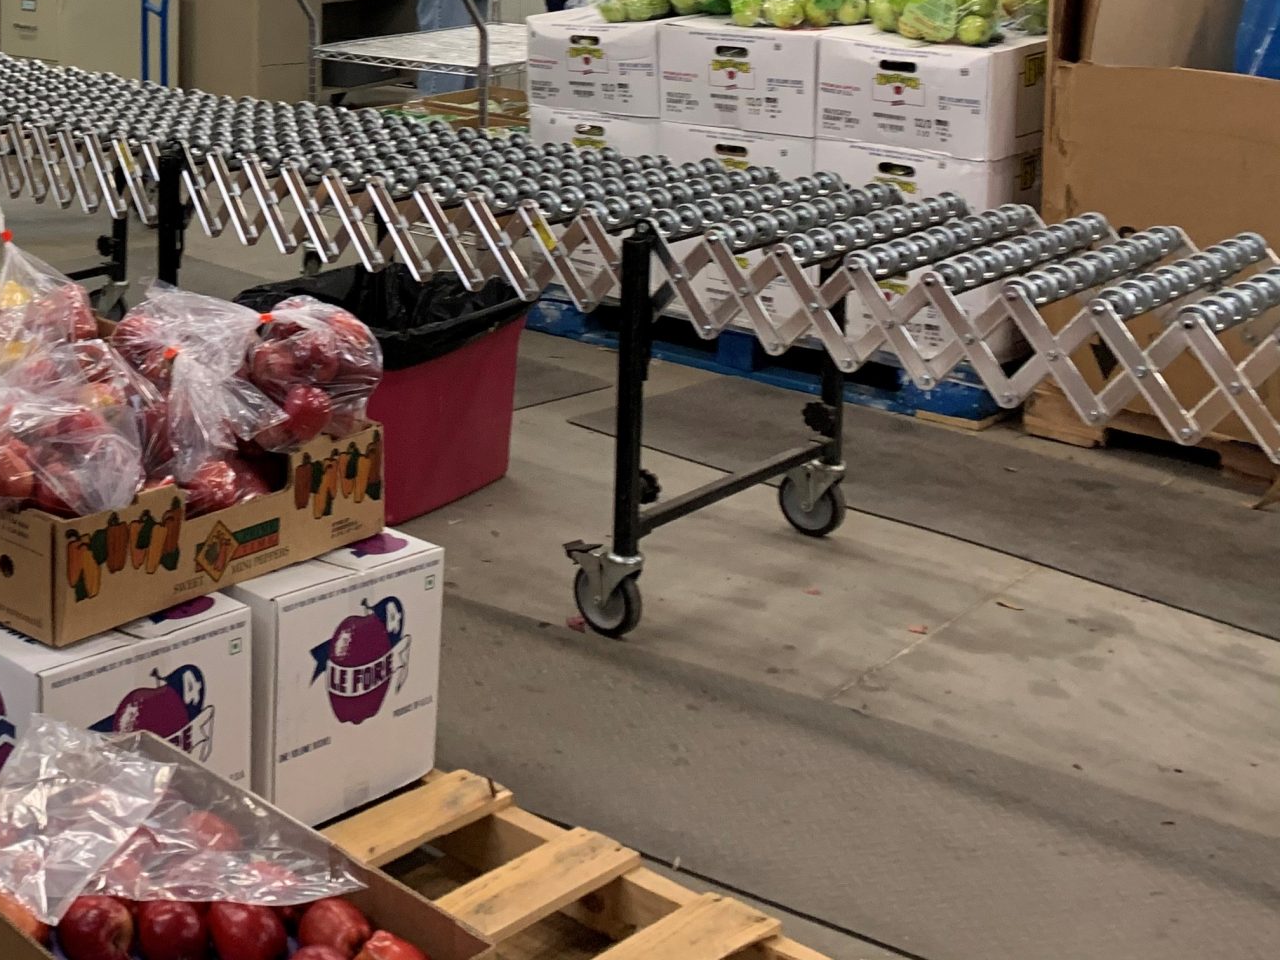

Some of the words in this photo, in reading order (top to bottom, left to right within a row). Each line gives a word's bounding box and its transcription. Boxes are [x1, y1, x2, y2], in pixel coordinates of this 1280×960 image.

[173, 576, 205, 594] SWEET
[255, 546, 290, 567] PEPPERS
[329, 665, 347, 694] LE
[352, 651, 395, 694] FORE
